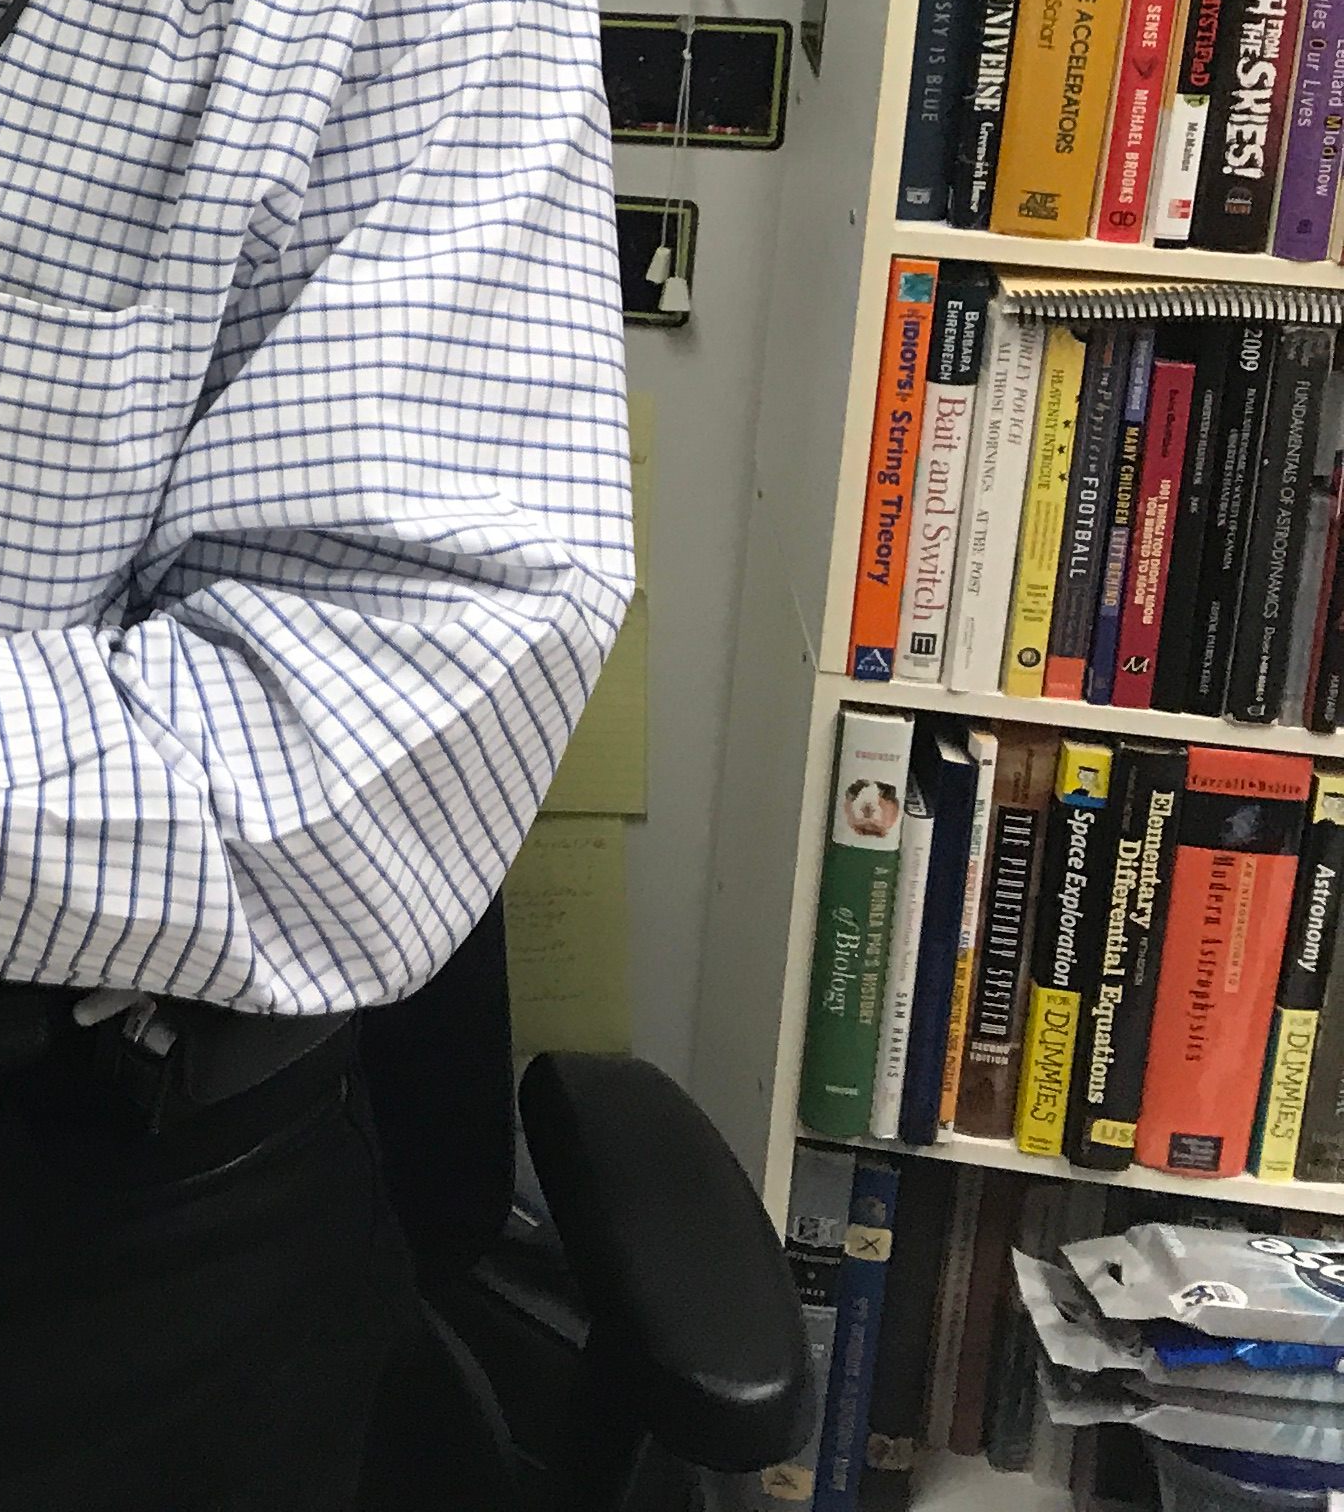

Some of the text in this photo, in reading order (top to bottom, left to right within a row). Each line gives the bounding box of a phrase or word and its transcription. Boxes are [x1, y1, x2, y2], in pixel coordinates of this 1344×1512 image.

[932, 0, 953, 38] SKY
[1141, 3, 1162, 49] SENSE
[1239, 21, 1266, 59] THE
[1264, 18, 1285, 60] FROM
[927, 46, 947, 66] IS
[1054, 8, 1095, 155] ACCELERATORS
[1305, 38, 1328, 72] Our
[920, 74, 944, 123] BLUE
[1126, 88, 1150, 148] MICHAEL
[1221, 55, 1278, 180] SKIES!
[1296, 78, 1322, 129] Lives
[1315, 38, 1344, 197] Leonard Mlodinow
[1118, 151, 1141, 205] BROOKS
[1180, 120, 1199, 173] McMahon
[939, 299, 964, 382] EHRENREICH
[958, 310, 980, 374] BARBARA
[1240, 327, 1263, 372] 2009
[1007, 320, 1039, 446] HIRLEY POVICH
[866, 316, 921, 587] IDIOT'S String Theory
[1036, 368, 1066, 491] HEAVENLY INTRIGUE
[1123, 425, 1141, 463] MANY
[1279, 379, 1312, 484] FUNDAMENTALS
[967, 341, 1012, 597] ALL THOSE MORNINGS AT THE POST
[1115, 465, 1135, 527] CHILDREN
[1279, 487, 1296, 506] OF
[912, 395, 968, 621] Bait and Switch
[1069, 476, 1100, 580] FOOTBALL
[1157, 502, 1170, 535] THINGS
[1110, 529, 1130, 560] LEFT
[1134, 496, 1159, 605] YOU WANTED TO KNOW
[1154, 536, 1165, 555] YOU
[1263, 507, 1292, 619] ASTRODYNAMICS
[1103, 561, 1124, 608] BEHIND
[1142, 587, 1156, 625] KNOW
[874, 865, 890, 876] A
[1128, 788, 1176, 931] Elementary
[868, 879, 889, 929] GUINEA
[978, 813, 1034, 1037] THE PLANETARY SYSTEM
[1052, 807, 1096, 988] Space Exploration
[1102, 838, 1143, 977] Differential
[1297, 862, 1337, 973] Astronomy
[821, 905, 862, 1019] of Biology
[1184, 855, 1236, 1062] Modern Astrophysics
[859, 972, 880, 1026] HISTORY
[887, 991, 909, 1080] SAM HARRIS
[971, 1040, 1012, 1056] SECOND
[1029, 1008, 1072, 1126] DUMMIES
[1087, 982, 1124, 1106] Equations
[1270, 1030, 1311, 1141] DUMMIES
